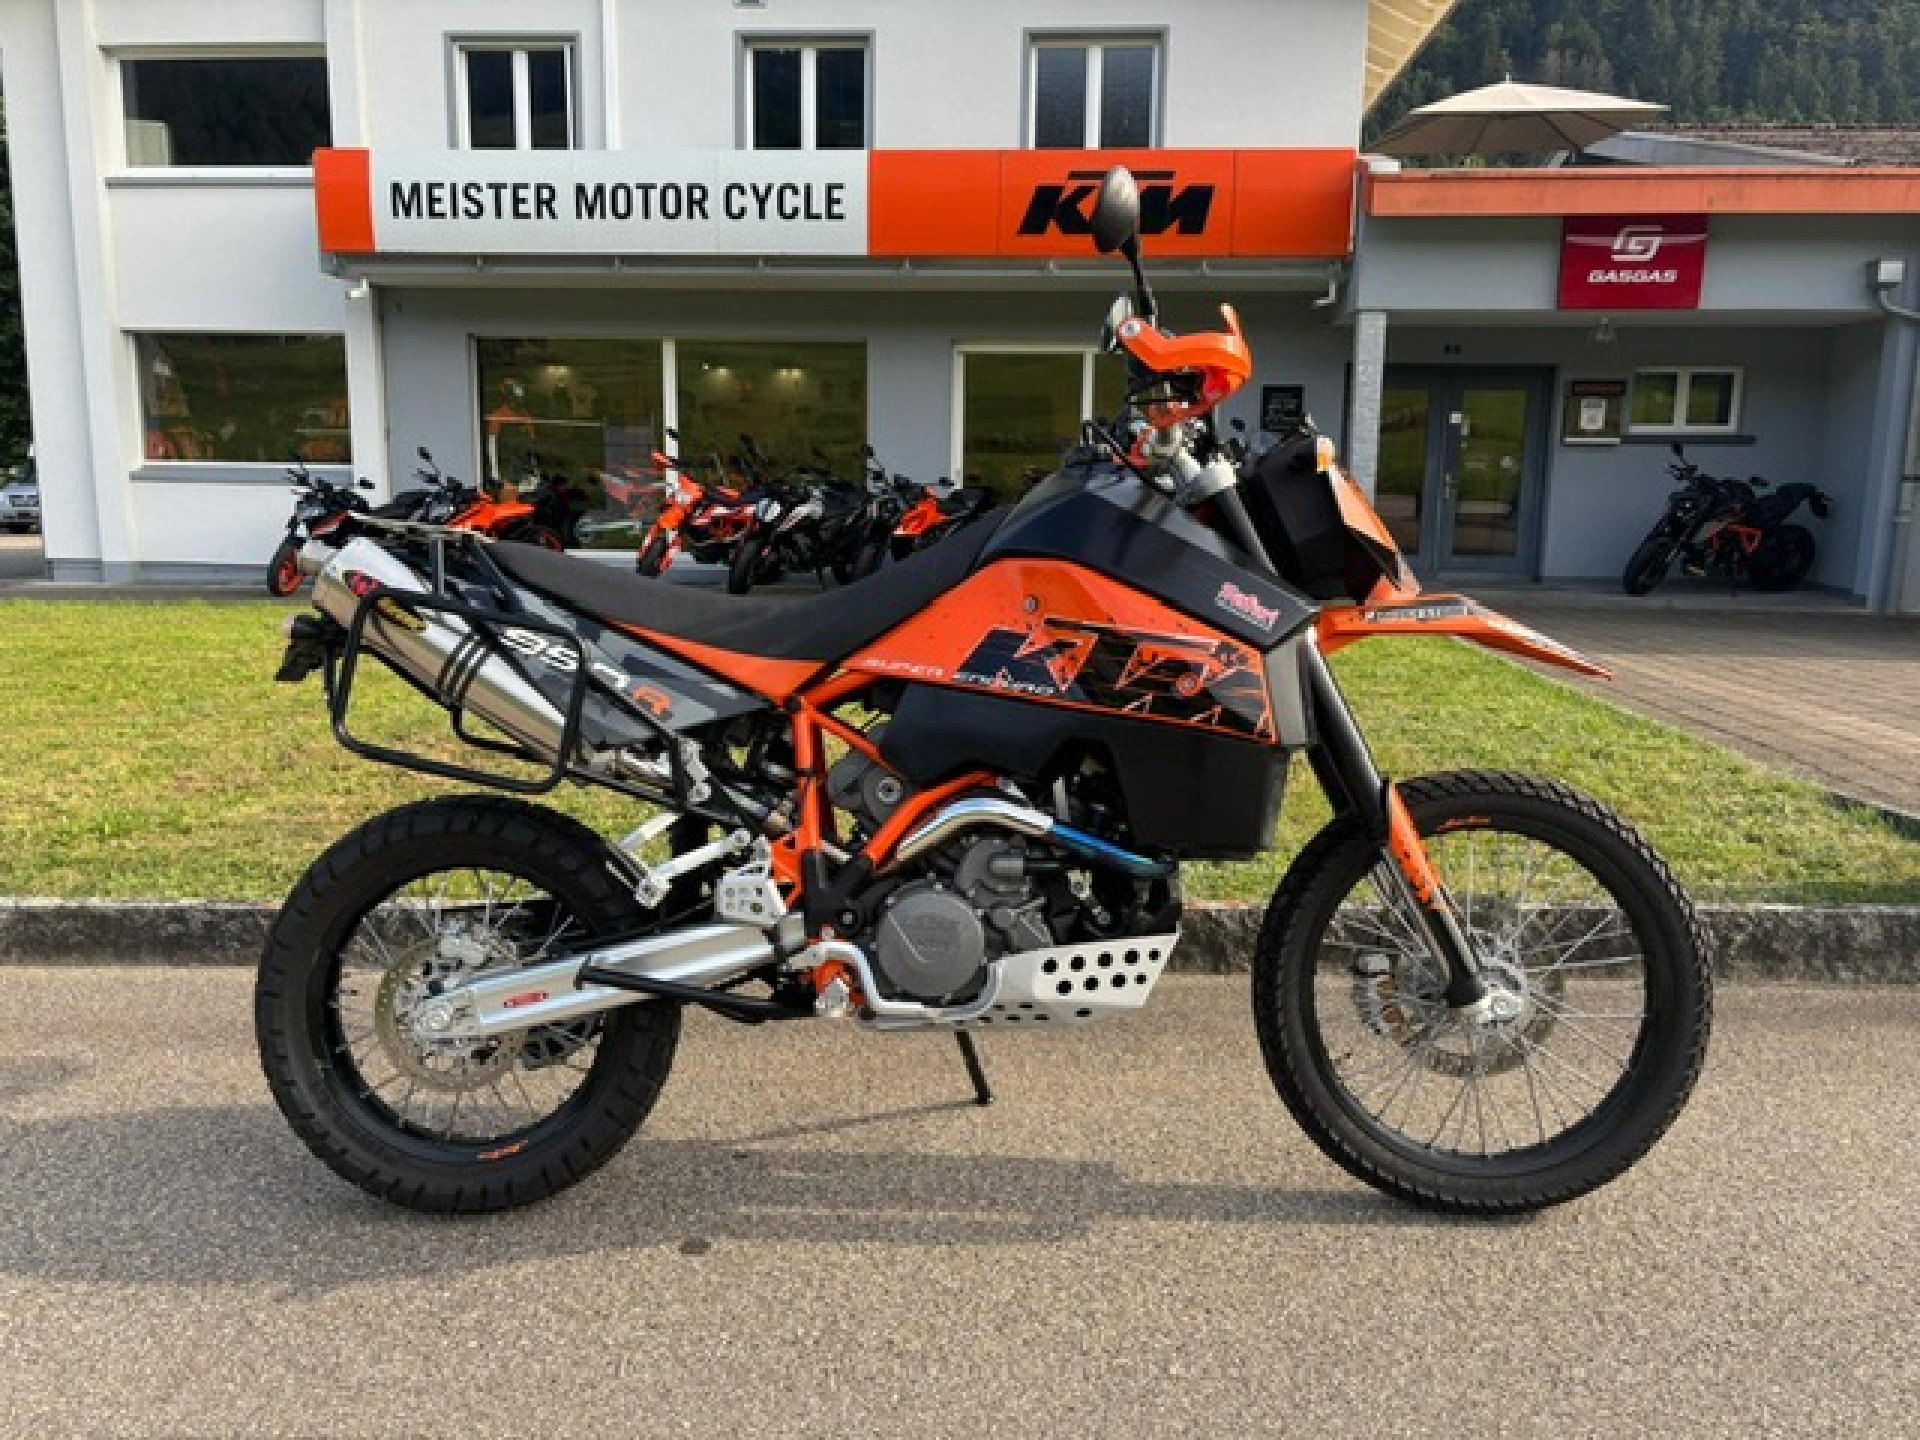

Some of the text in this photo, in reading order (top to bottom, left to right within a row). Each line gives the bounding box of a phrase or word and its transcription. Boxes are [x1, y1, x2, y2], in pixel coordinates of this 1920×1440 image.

[390, 181, 847, 221] MEISTER MOTOR CYCLE
[1587, 269, 1678, 284] GASGAS
